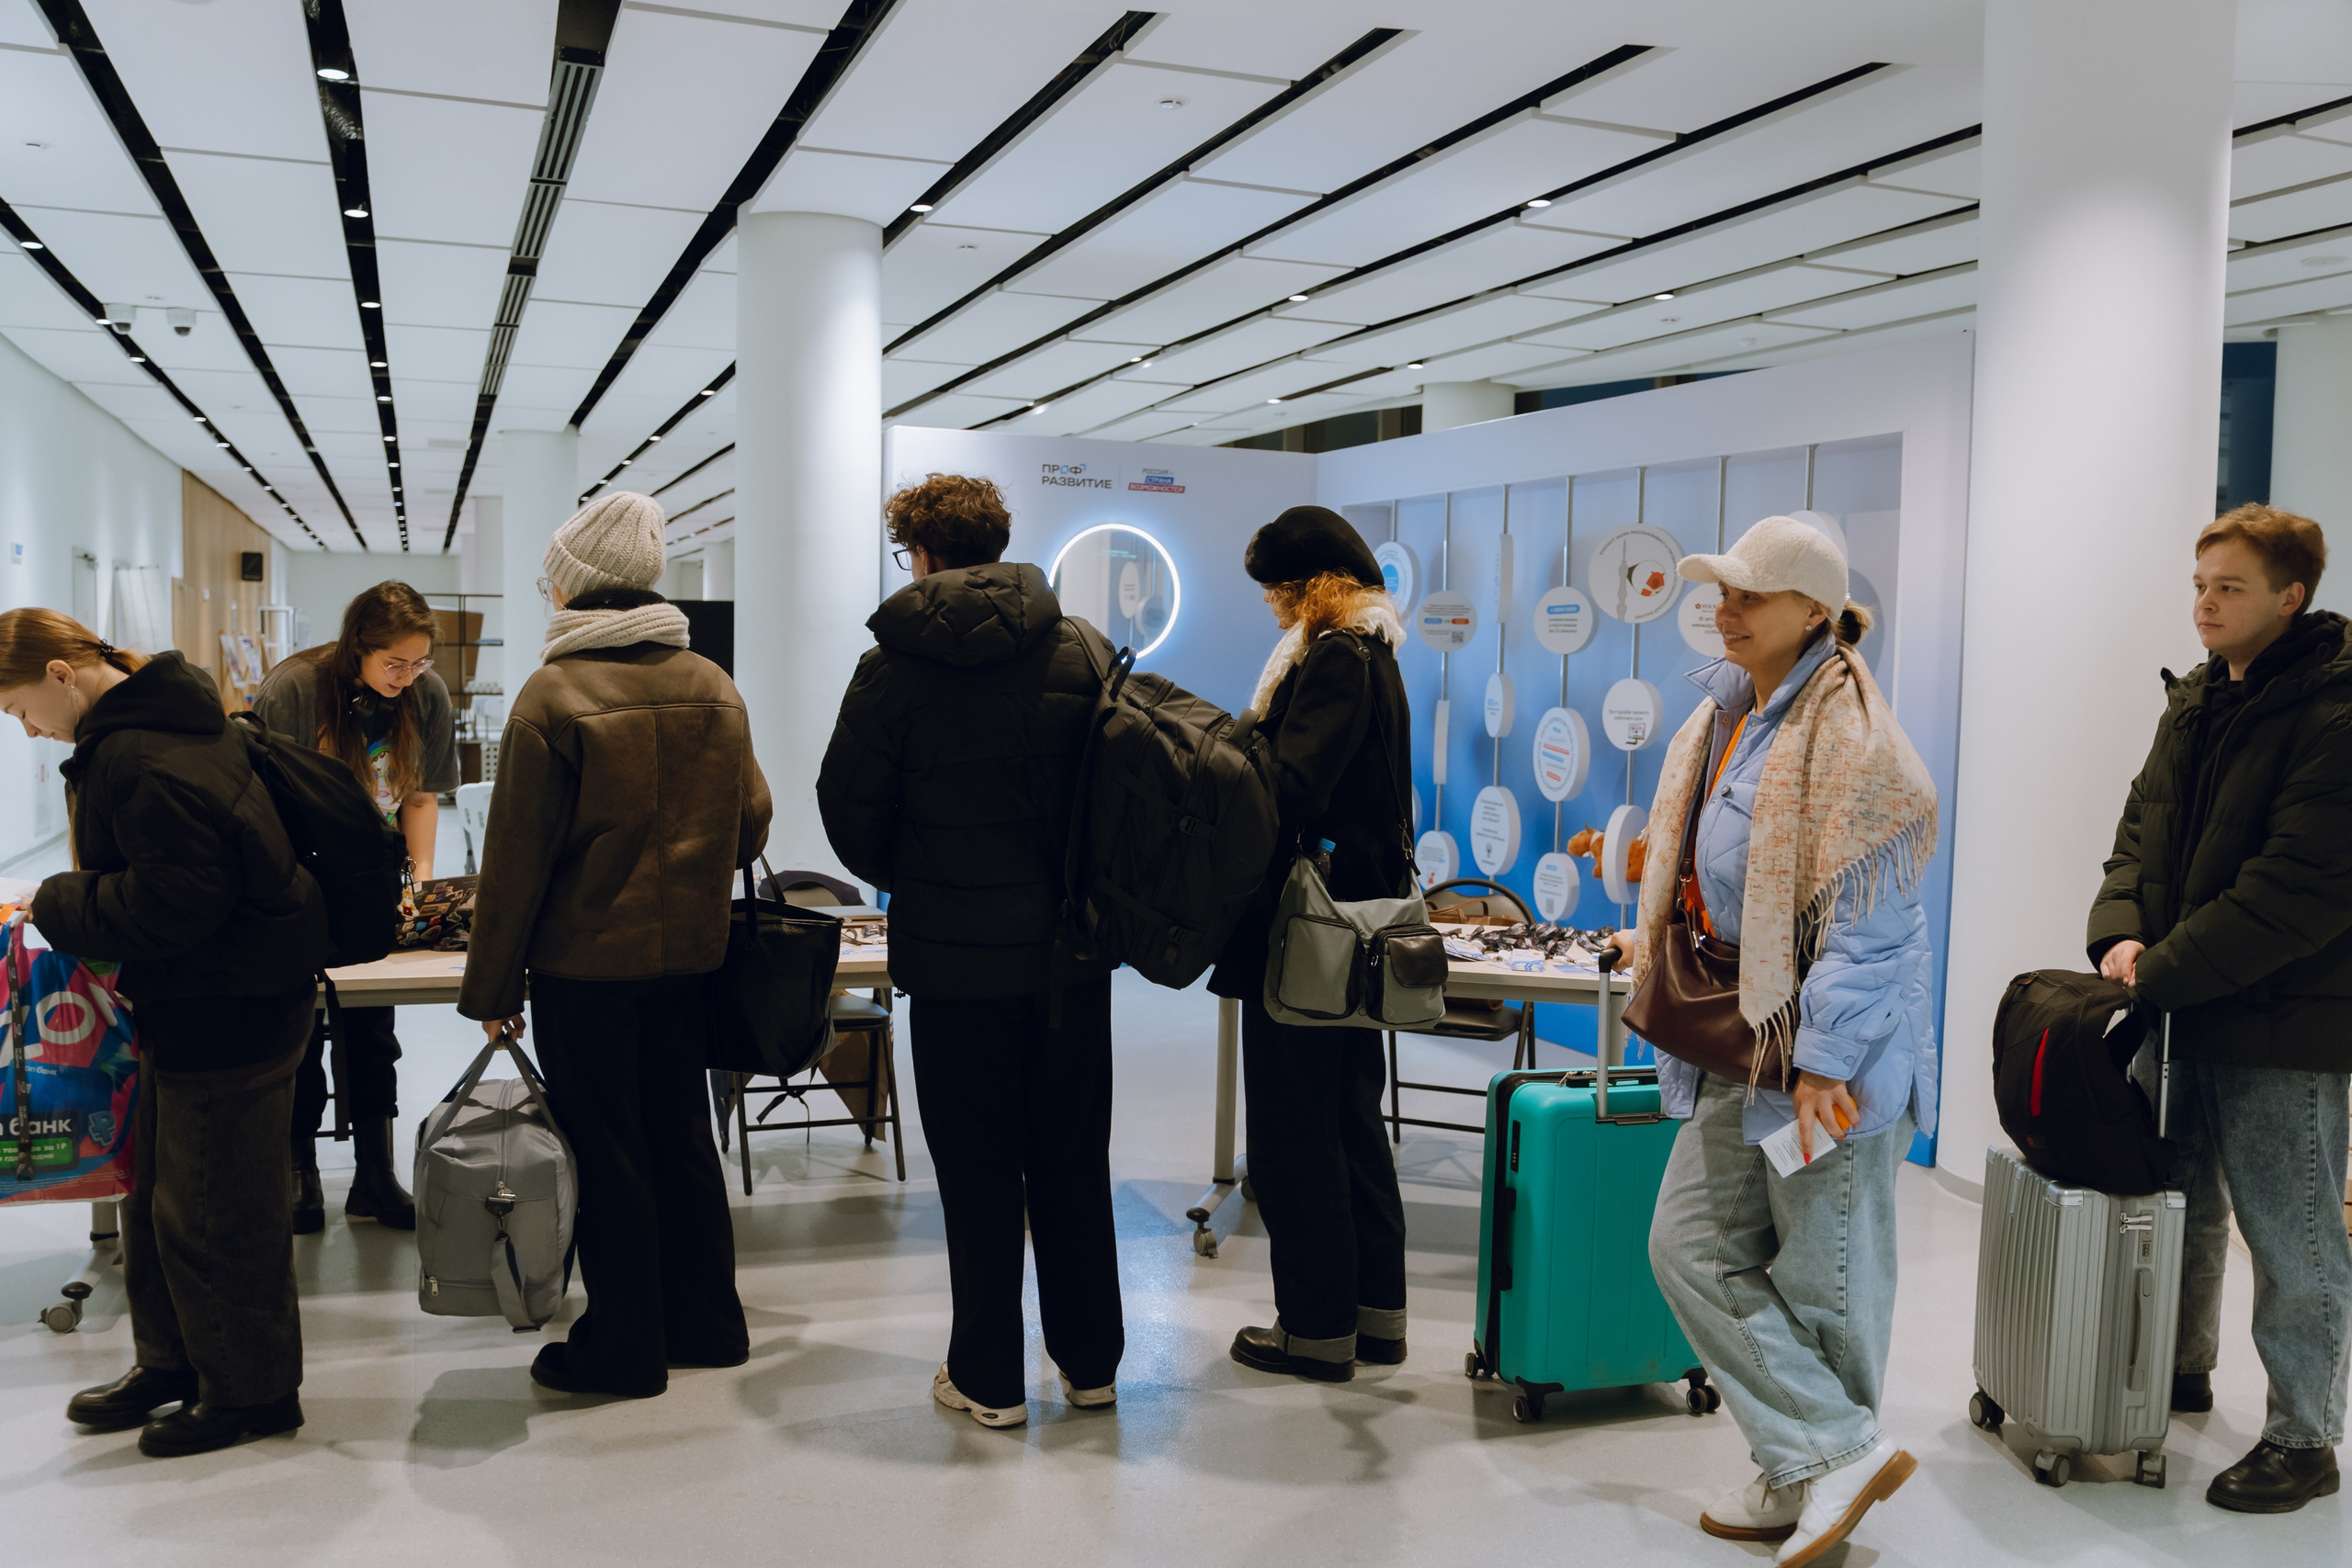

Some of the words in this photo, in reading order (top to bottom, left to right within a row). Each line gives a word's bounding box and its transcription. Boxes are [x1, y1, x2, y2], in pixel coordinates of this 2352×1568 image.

[1042, 464, 1083, 475] ПРОФ
[1042, 476, 1113, 489] РАЗВИТИЕ
[9, 1117, 73, 1135] банк
